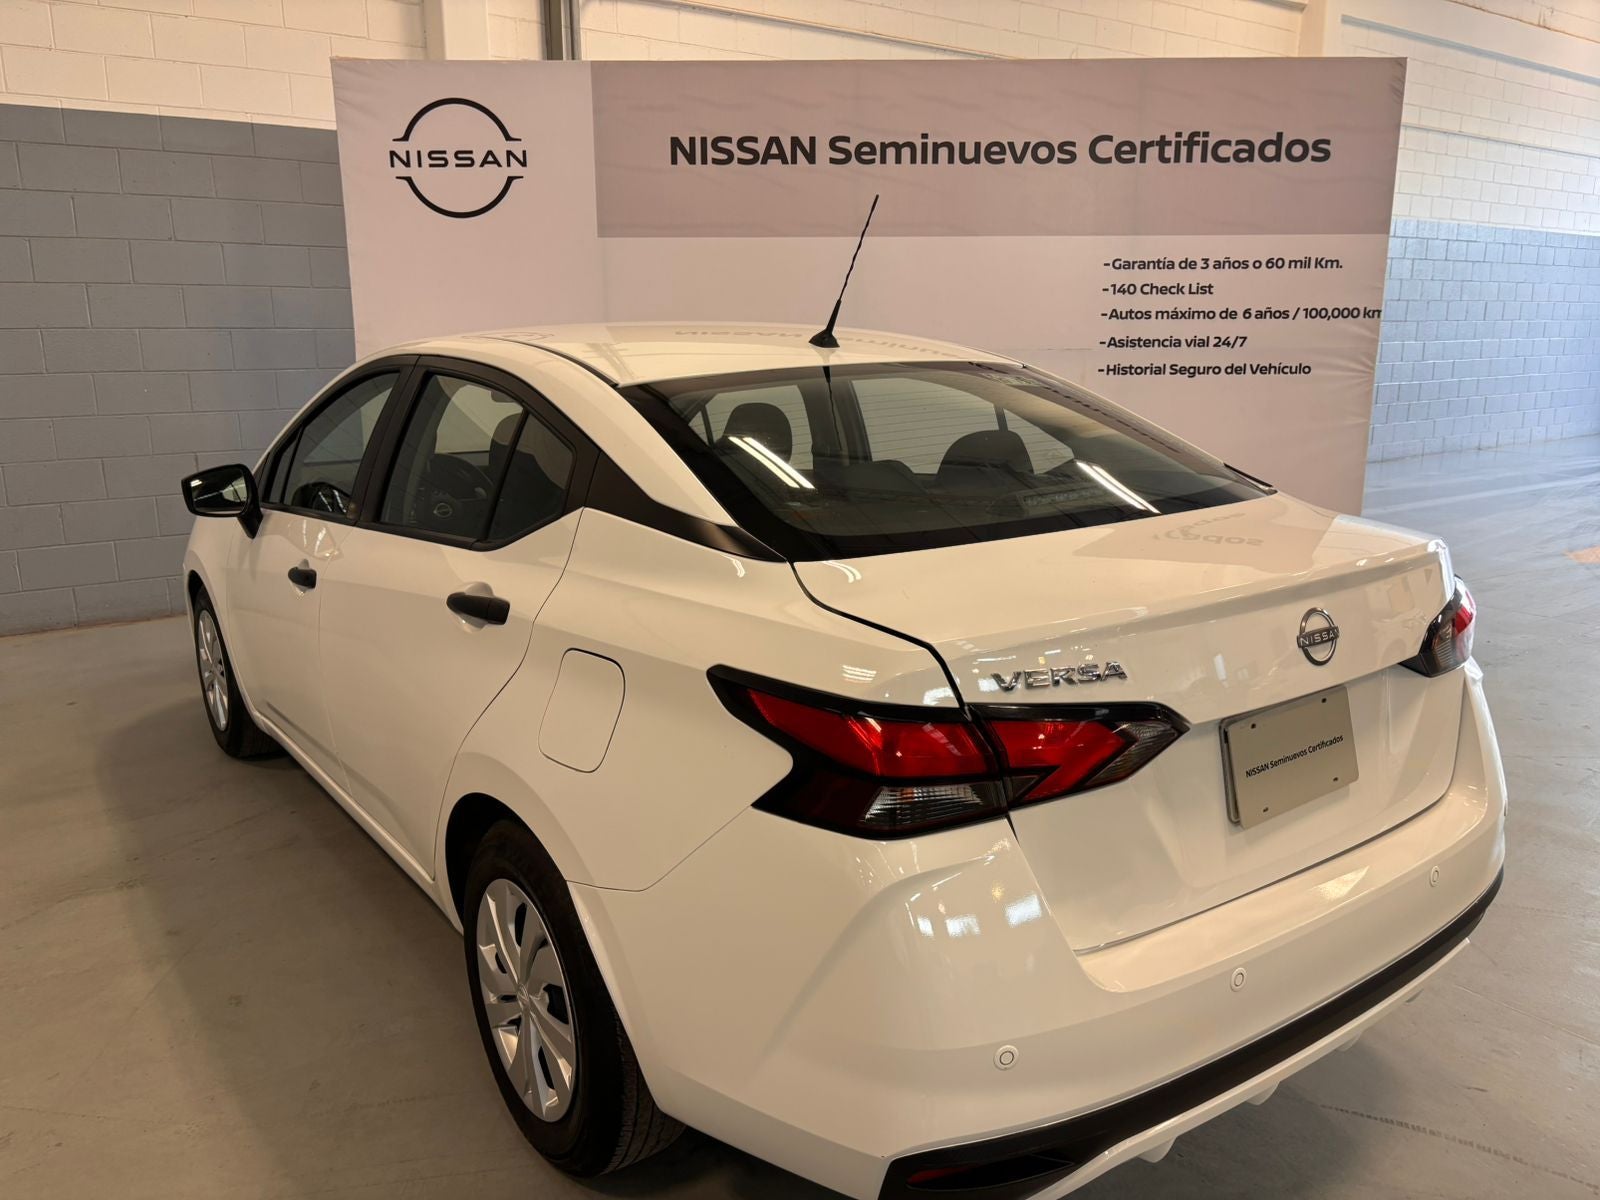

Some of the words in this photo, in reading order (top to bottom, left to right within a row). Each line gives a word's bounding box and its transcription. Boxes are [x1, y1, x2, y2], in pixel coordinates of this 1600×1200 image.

[670, 135, 817, 166] NISSAN
[828, 134, 1077, 165] Seminuevos
[1088, 131, 1332, 164] Certificados
[389, 149, 528, 168] NISSAN
[1178, 257, 1197, 270] de
[1200, 258, 1210, 270] 3
[1212, 256, 1250, 270] años
[1252, 260, 1262, 270] o
[1265, 257, 1285, 269] 60
[1288, 256, 1312, 269] mil
[1314, 257, 1343, 269] Km.
[1140, 283, 1186, 295] Check
[1188, 282, 1214, 295] List
[1155, 307, 1216, 320] máximo
[1219, 308, 1238, 320] de
[1242, 308, 1252, 320] 6
[1254, 306, 1290, 320] años
[1292, 307, 1300, 320] /
[1302, 307, 1360, 321] 100,000
[1185, 335, 1210, 348] vial
[1212, 336, 1248, 349] 24/7
[1169, 363, 1222, 378] Seguro
[1224, 363, 1247, 375] del
[1250, 362, 1312, 375] Vehículo
[1298, 627, 1340, 648] NISSAN
[991, 660, 1128, 693] VERSA
[1245, 762, 1270, 779] NISSAN
[1269, 748, 1308, 769] Seminuevos
[1307, 734, 1344, 755] Certificados
